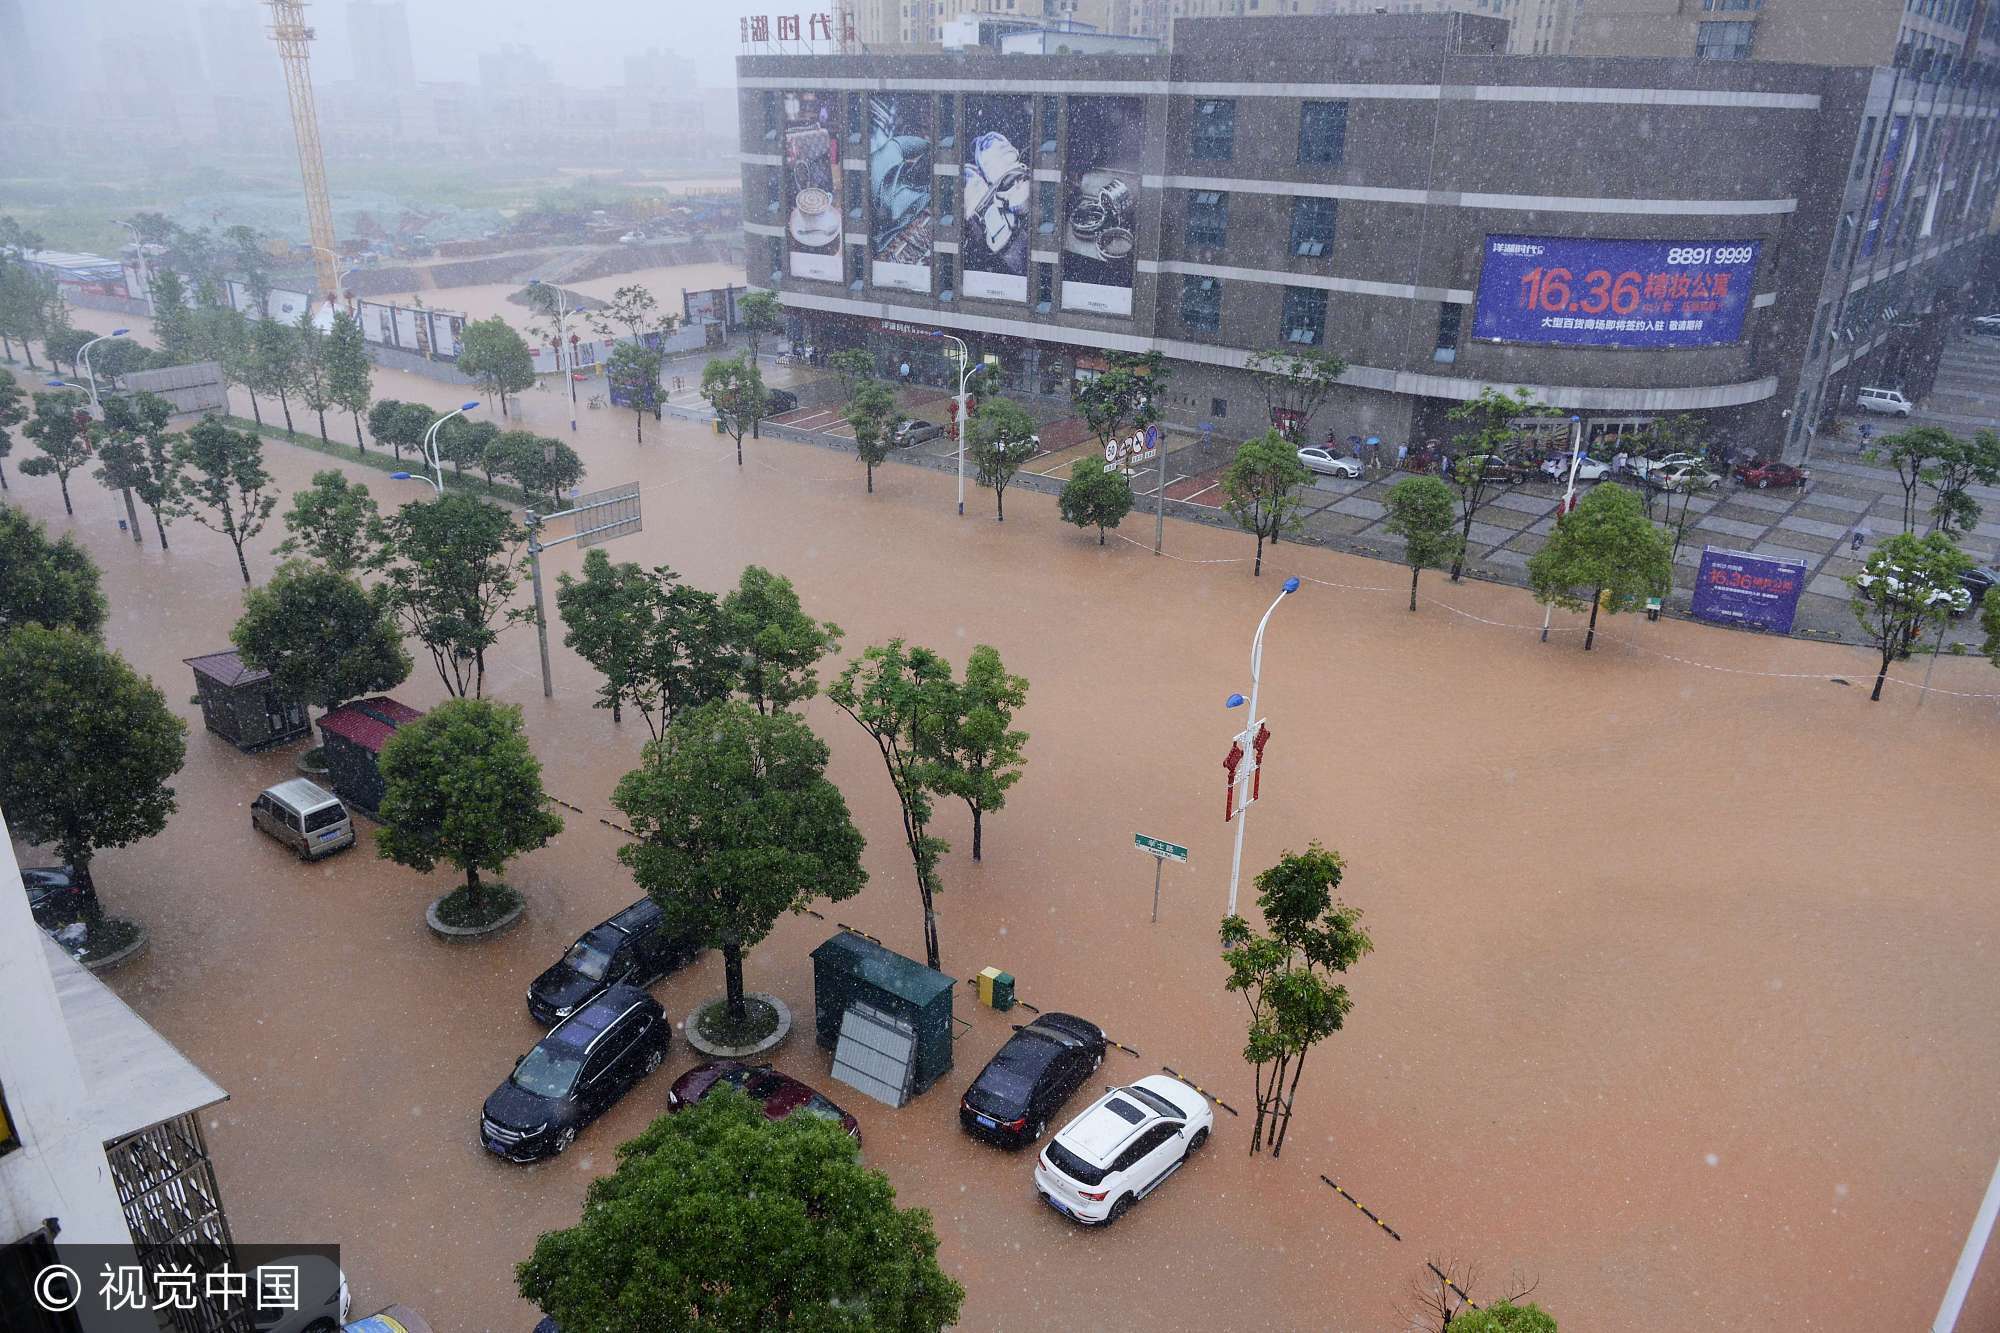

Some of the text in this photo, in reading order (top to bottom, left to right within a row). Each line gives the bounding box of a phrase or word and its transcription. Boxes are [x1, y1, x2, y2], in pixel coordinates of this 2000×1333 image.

[1667, 247, 1752, 265] 8891 9999
[1522, 267, 1642, 315] 16.36
[1541, 317, 1665, 331] 大型百货商场即将签约入驻
